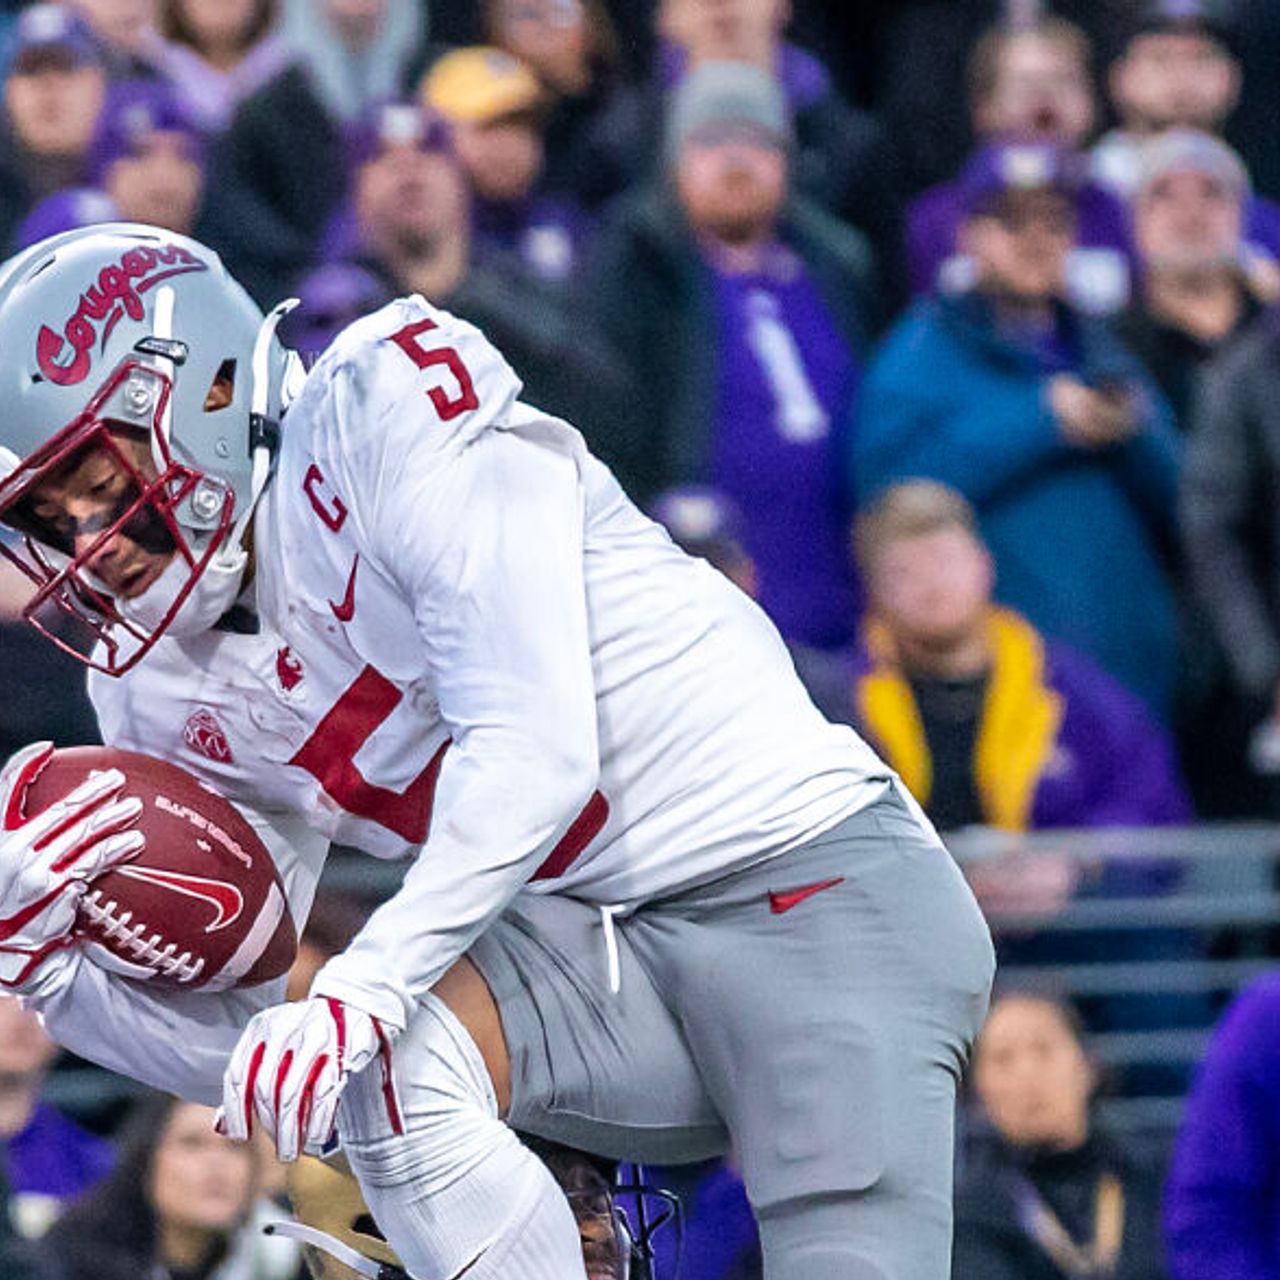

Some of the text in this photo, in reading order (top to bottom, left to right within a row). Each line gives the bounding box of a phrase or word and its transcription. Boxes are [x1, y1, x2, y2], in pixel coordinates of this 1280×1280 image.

[36, 245, 208, 386] Cougars
[388, 317, 480, 422] 5
[303, 463, 349, 534] C
